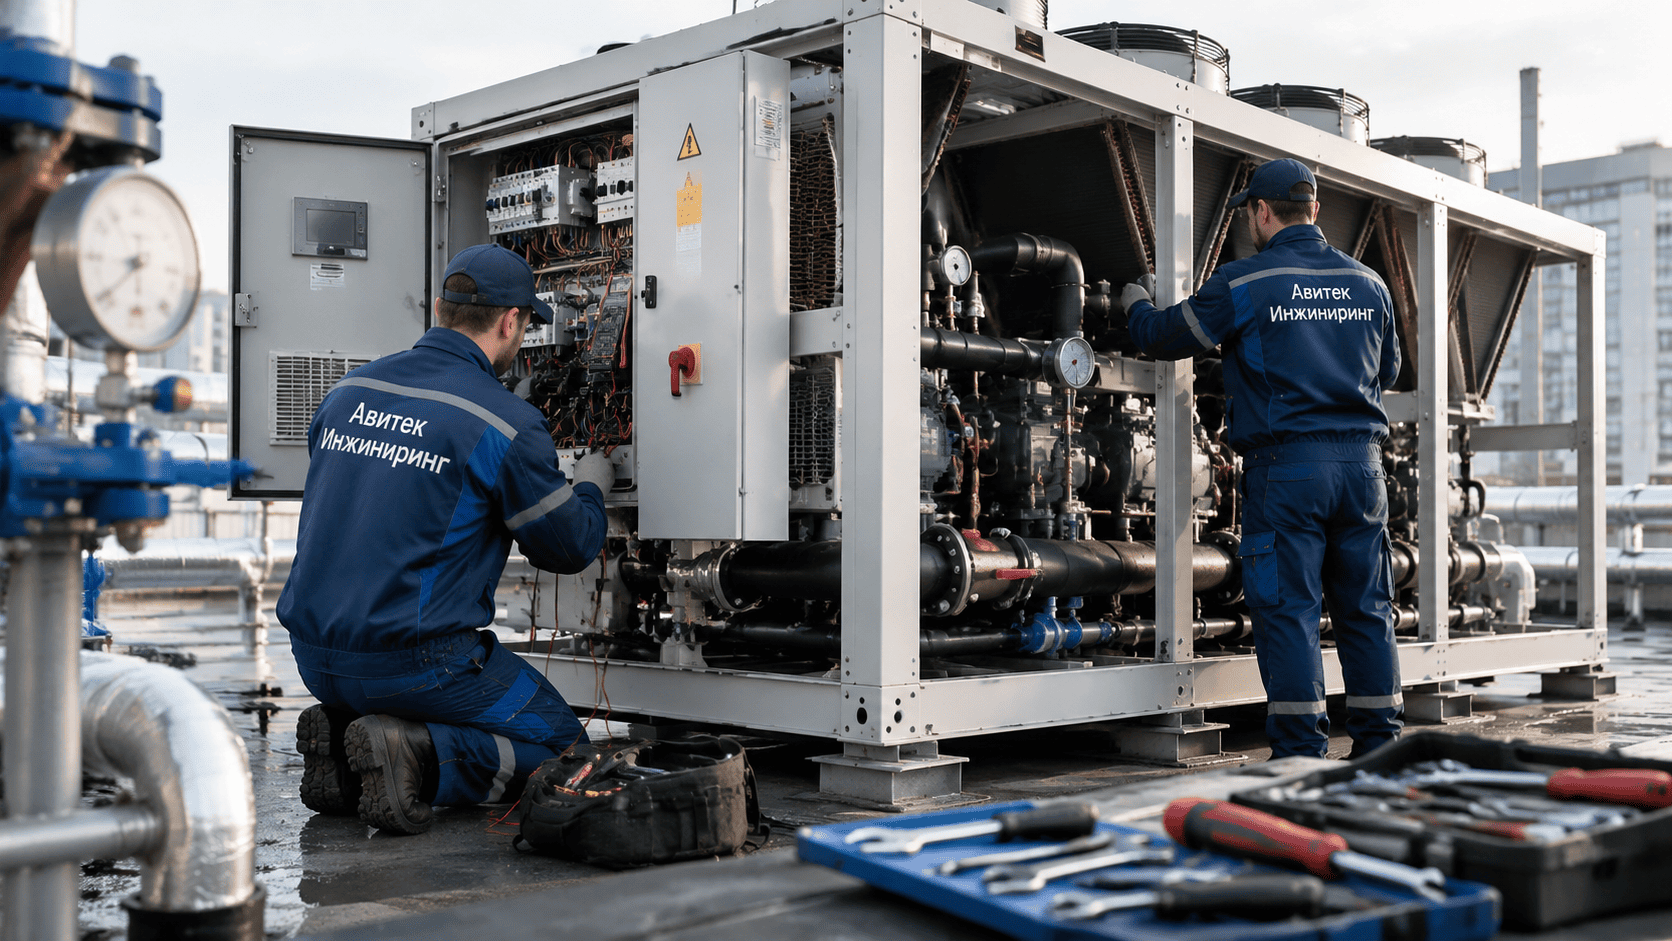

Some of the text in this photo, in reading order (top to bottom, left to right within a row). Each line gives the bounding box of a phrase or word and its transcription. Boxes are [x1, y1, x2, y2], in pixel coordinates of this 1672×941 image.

[1291, 283, 1352, 300] Авитек
[1269, 305, 1375, 324] Инжиниринг
[348, 402, 428, 437] Авитек
[320, 427, 451, 474] Инжиниринг
